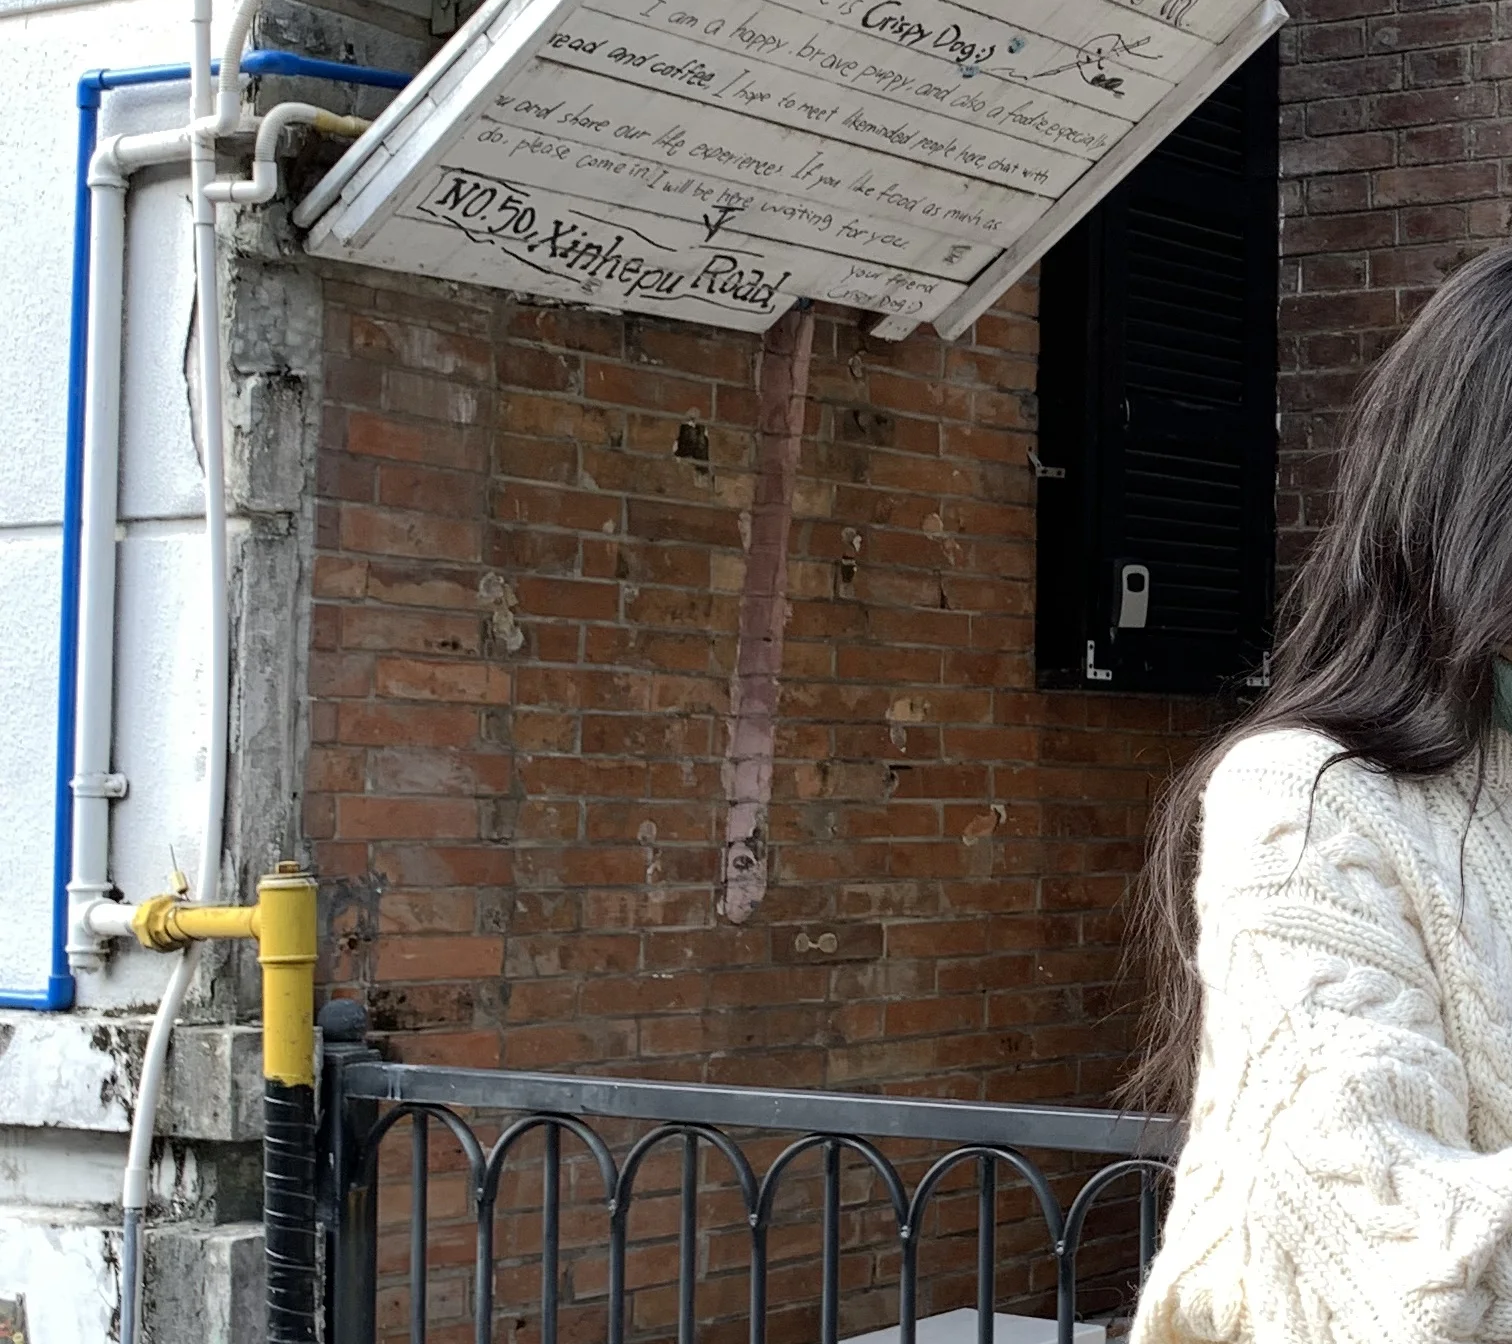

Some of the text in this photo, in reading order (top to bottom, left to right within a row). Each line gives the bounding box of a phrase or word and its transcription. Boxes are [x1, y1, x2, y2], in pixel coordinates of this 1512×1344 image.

[668, 11, 699, 30] am
[796, 34, 858, 78] brave
[914, 82, 960, 103] and
[951, 90, 987, 114] also
[861, 0, 931, 48] Crispy
[547, 32, 609, 55] read
[607, 46, 655, 68] and
[711, 68, 750, 99] I
[732, 80, 772, 106] hope
[777, 93, 798, 110] to
[797, 100, 838, 122] meet
[915, 135, 959, 159] people
[991, 157, 1020, 177] chat
[1021, 166, 1051, 185] with
[509, 136, 572, 161] please
[662, 176, 693, 198] will
[692, 181, 712, 203] be
[718, 184, 755, 209] here
[760, 200, 833, 232] waiting
[839, 218, 871, 240] for
[514, 100, 566, 120] and
[557, 104, 611, 133] share
[613, 123, 652, 141] our
[651, 123, 687, 158] life
[791, 151, 822, 182] If
[807, 172, 842, 190] you
[848, 169, 876, 198] like
[877, 179, 922, 211] food
[922, 201, 943, 215] as
[983, 217, 1003, 231] as
